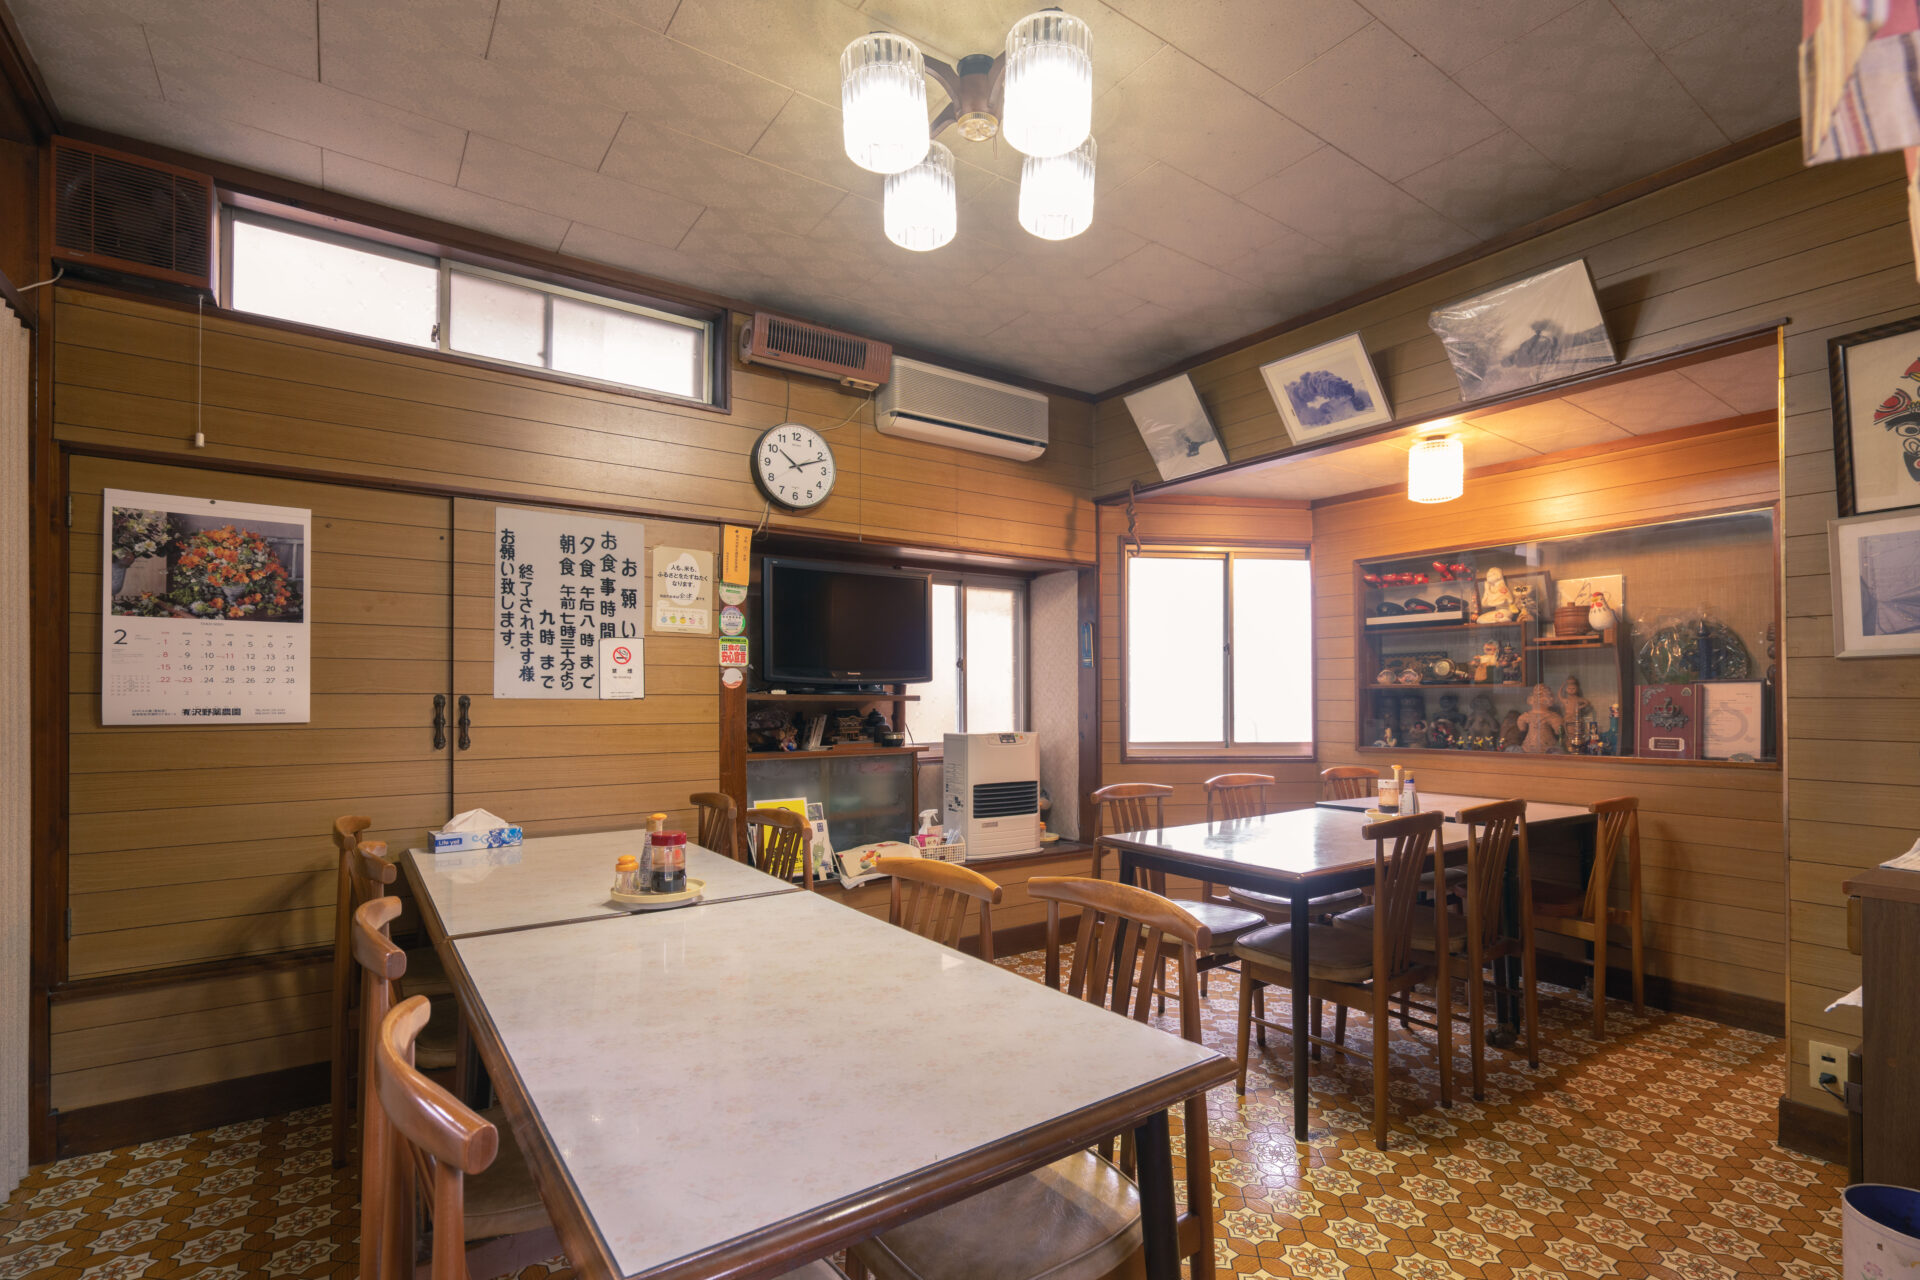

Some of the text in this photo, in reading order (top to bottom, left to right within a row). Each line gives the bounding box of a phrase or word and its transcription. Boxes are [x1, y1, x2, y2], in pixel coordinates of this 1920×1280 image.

[778, 434, 786, 443] 11
[792, 432, 801, 441] 12
[768, 444, 778, 453] 10
[818, 452, 823, 460] 2
[765, 457, 770, 466] 9
[821, 467, 826, 476] 3
[768, 473, 774, 481] 8
[807, 490, 812, 498] 5
[600, 531, 617, 638] お食事時間
[621, 558, 637, 638] お願い
[519, 564, 535, 682] 終了されます様
[113, 629, 127, 644] 2
[539, 609, 555, 689] 九時まで
[721, 651, 746, 663] 安心宣言
